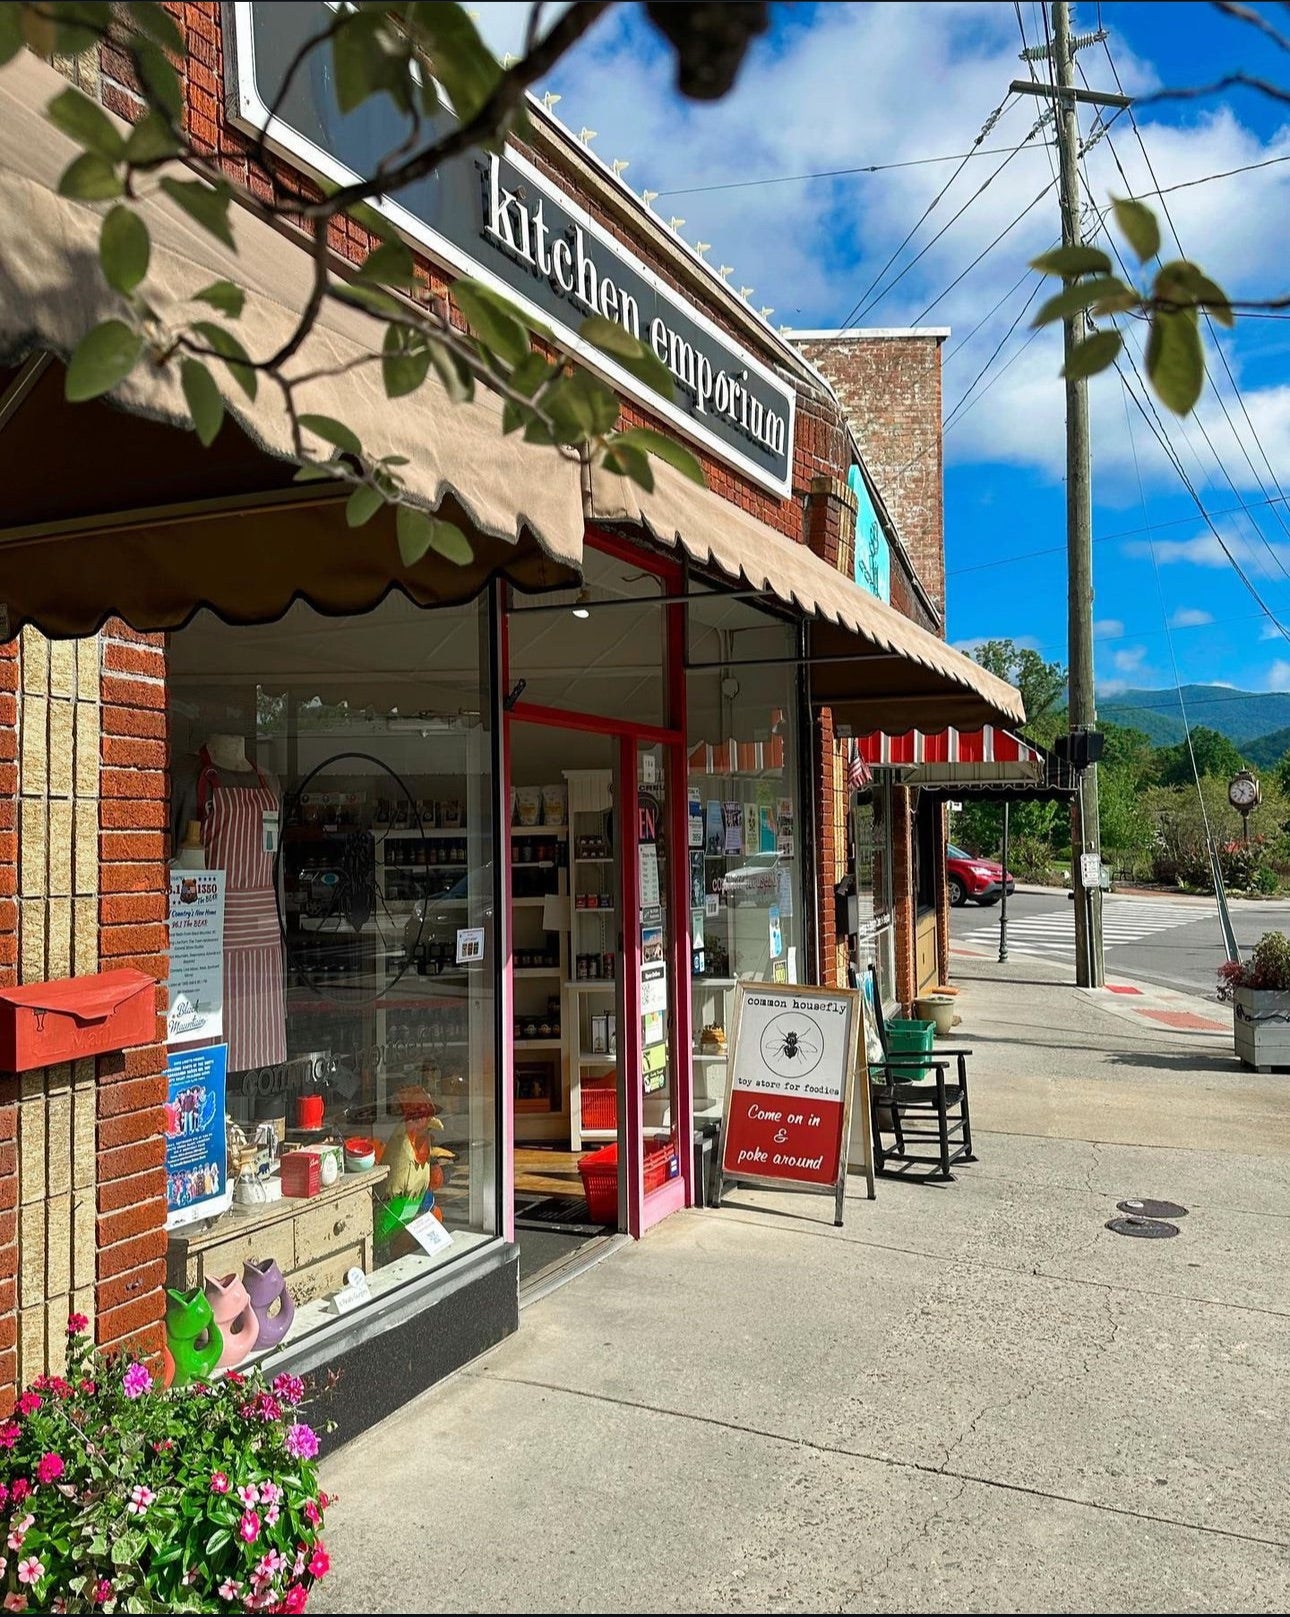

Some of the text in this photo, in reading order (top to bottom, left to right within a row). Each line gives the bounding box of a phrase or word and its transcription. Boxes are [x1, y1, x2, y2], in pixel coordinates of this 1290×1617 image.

[484, 151, 785, 456] kitchen emporium
[639, 807, 655, 840] EN
[197, 884, 217, 894] 1350
[183, 919, 193, 928] The
[177, 998, 199, 1018] Black
[748, 997, 847, 1015] common housefly
[168, 1014, 207, 1035] Mountain
[71, 1025, 112, 1049] Mail
[737, 1077, 839, 1095] toy store for foodies
[748, 1104, 820, 1127] Come on in
[773, 1128, 788, 1143] &
[738, 1147, 823, 1170] poke around
